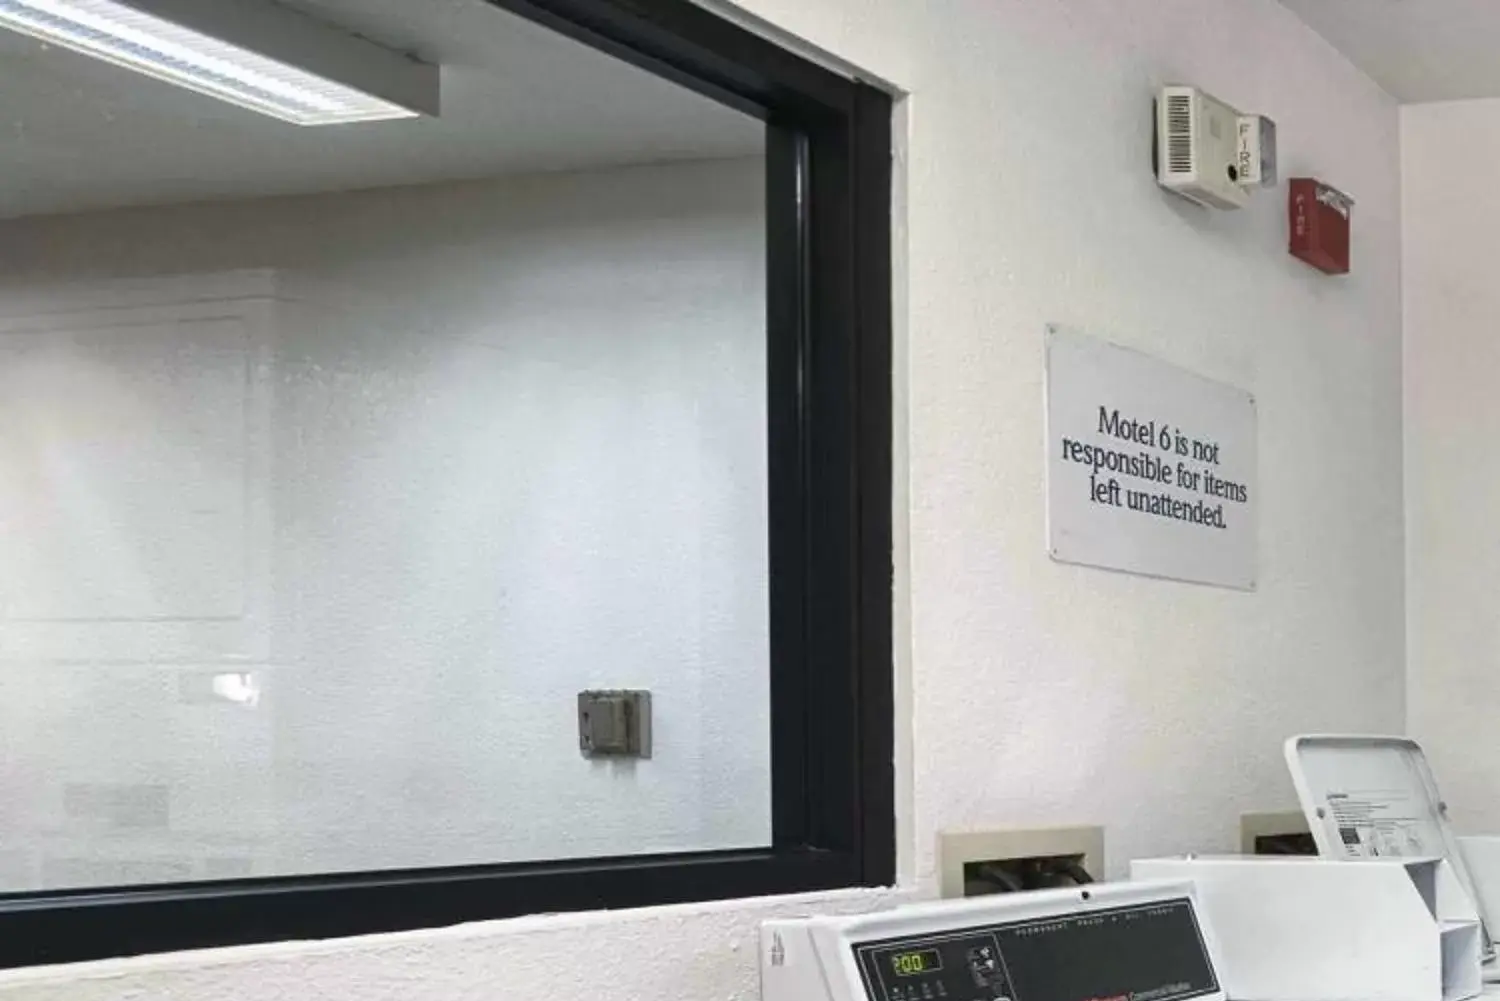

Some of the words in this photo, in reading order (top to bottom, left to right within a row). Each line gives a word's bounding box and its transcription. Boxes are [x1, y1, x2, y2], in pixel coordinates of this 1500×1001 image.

[1239, 123, 1251, 177] FIRE
[1098, 405, 1155, 447] Motel
[1159, 424, 1171, 451] 6
[1175, 427, 1189, 457] is
[1193, 439, 1219, 465] not
[1062, 437, 1173, 484] responsible
[1176, 461, 1201, 491] for
[1204, 469, 1247, 503] items
[1090, 475, 1122, 507] left
[1126, 489, 1227, 528] unattended.
